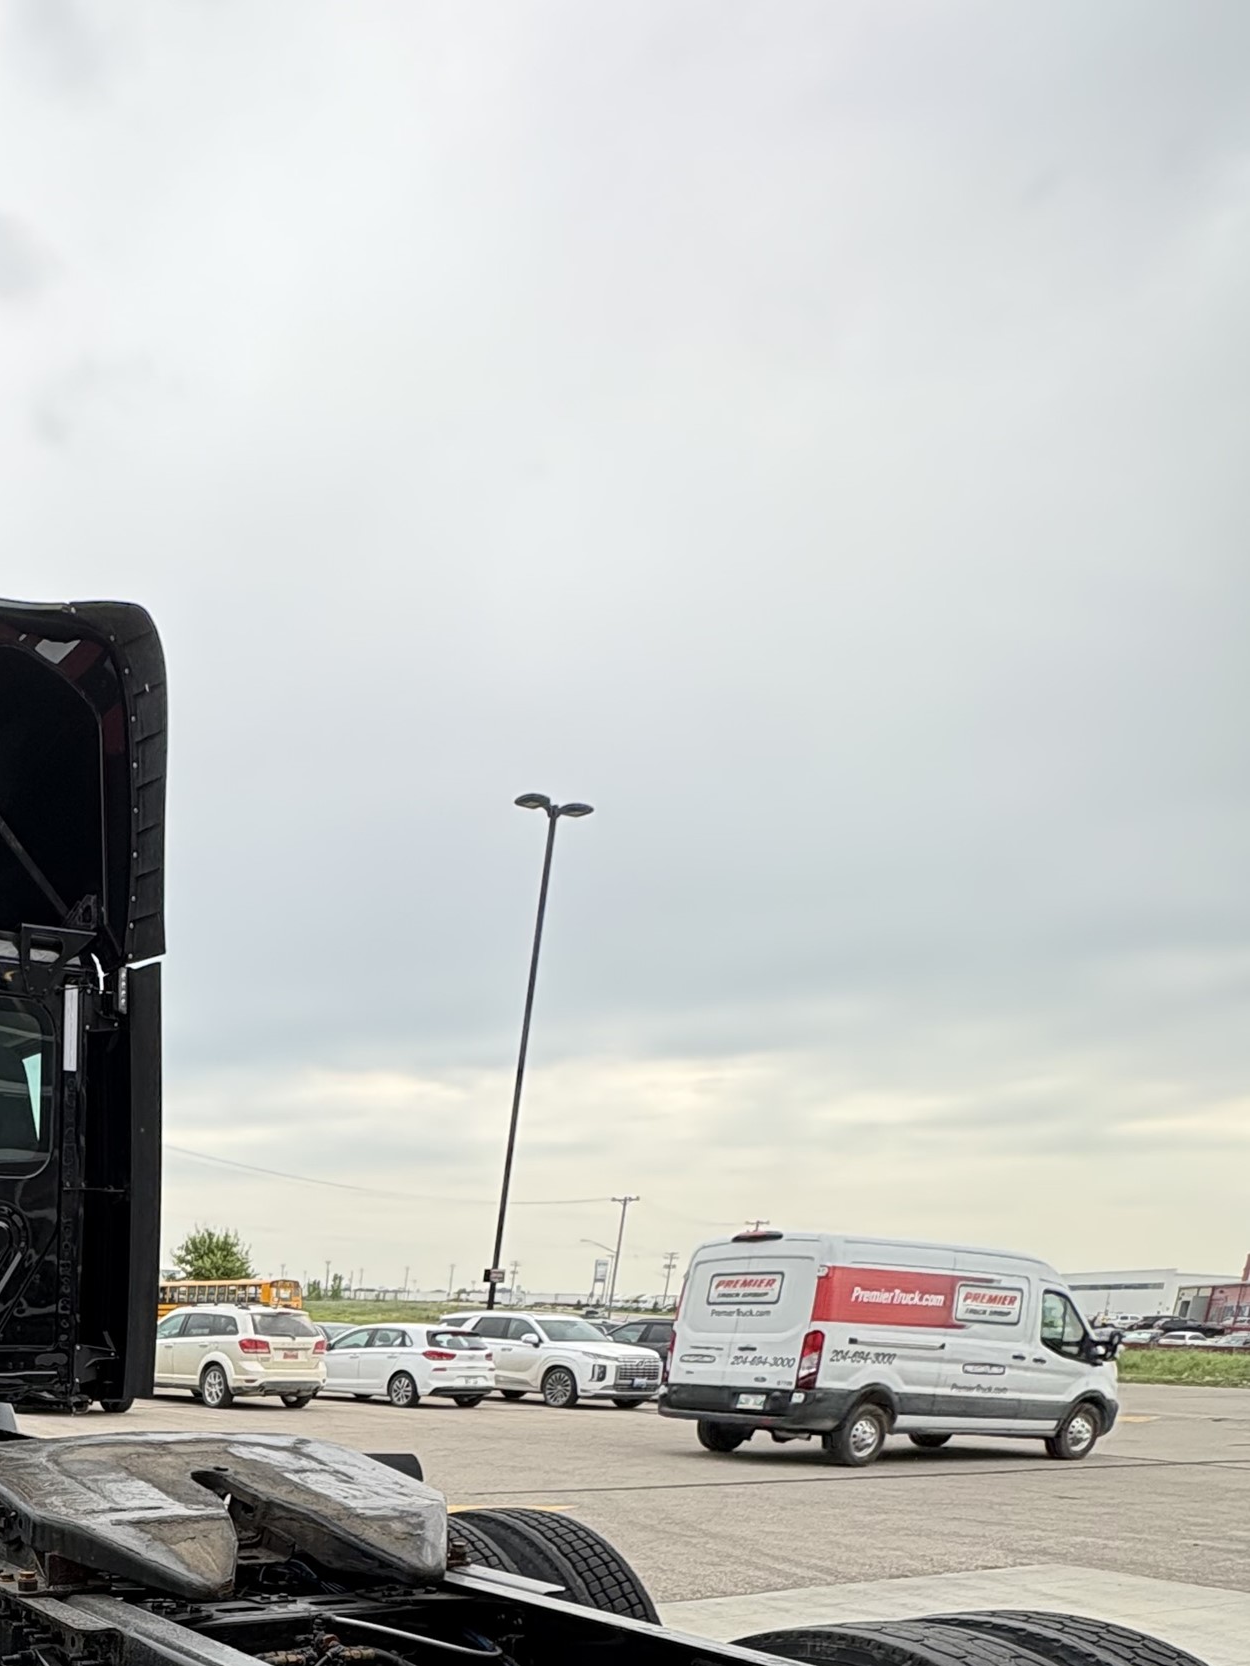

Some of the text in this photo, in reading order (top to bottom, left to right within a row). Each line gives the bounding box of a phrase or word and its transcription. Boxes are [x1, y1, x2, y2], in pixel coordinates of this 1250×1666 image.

[715, 1278, 776, 1290] PREMIER
[852, 1287, 945, 1306] PremierTruck.com
[963, 1292, 1017, 1306] PREMIER
[710, 1308, 771, 1317] PremierTruck.com
